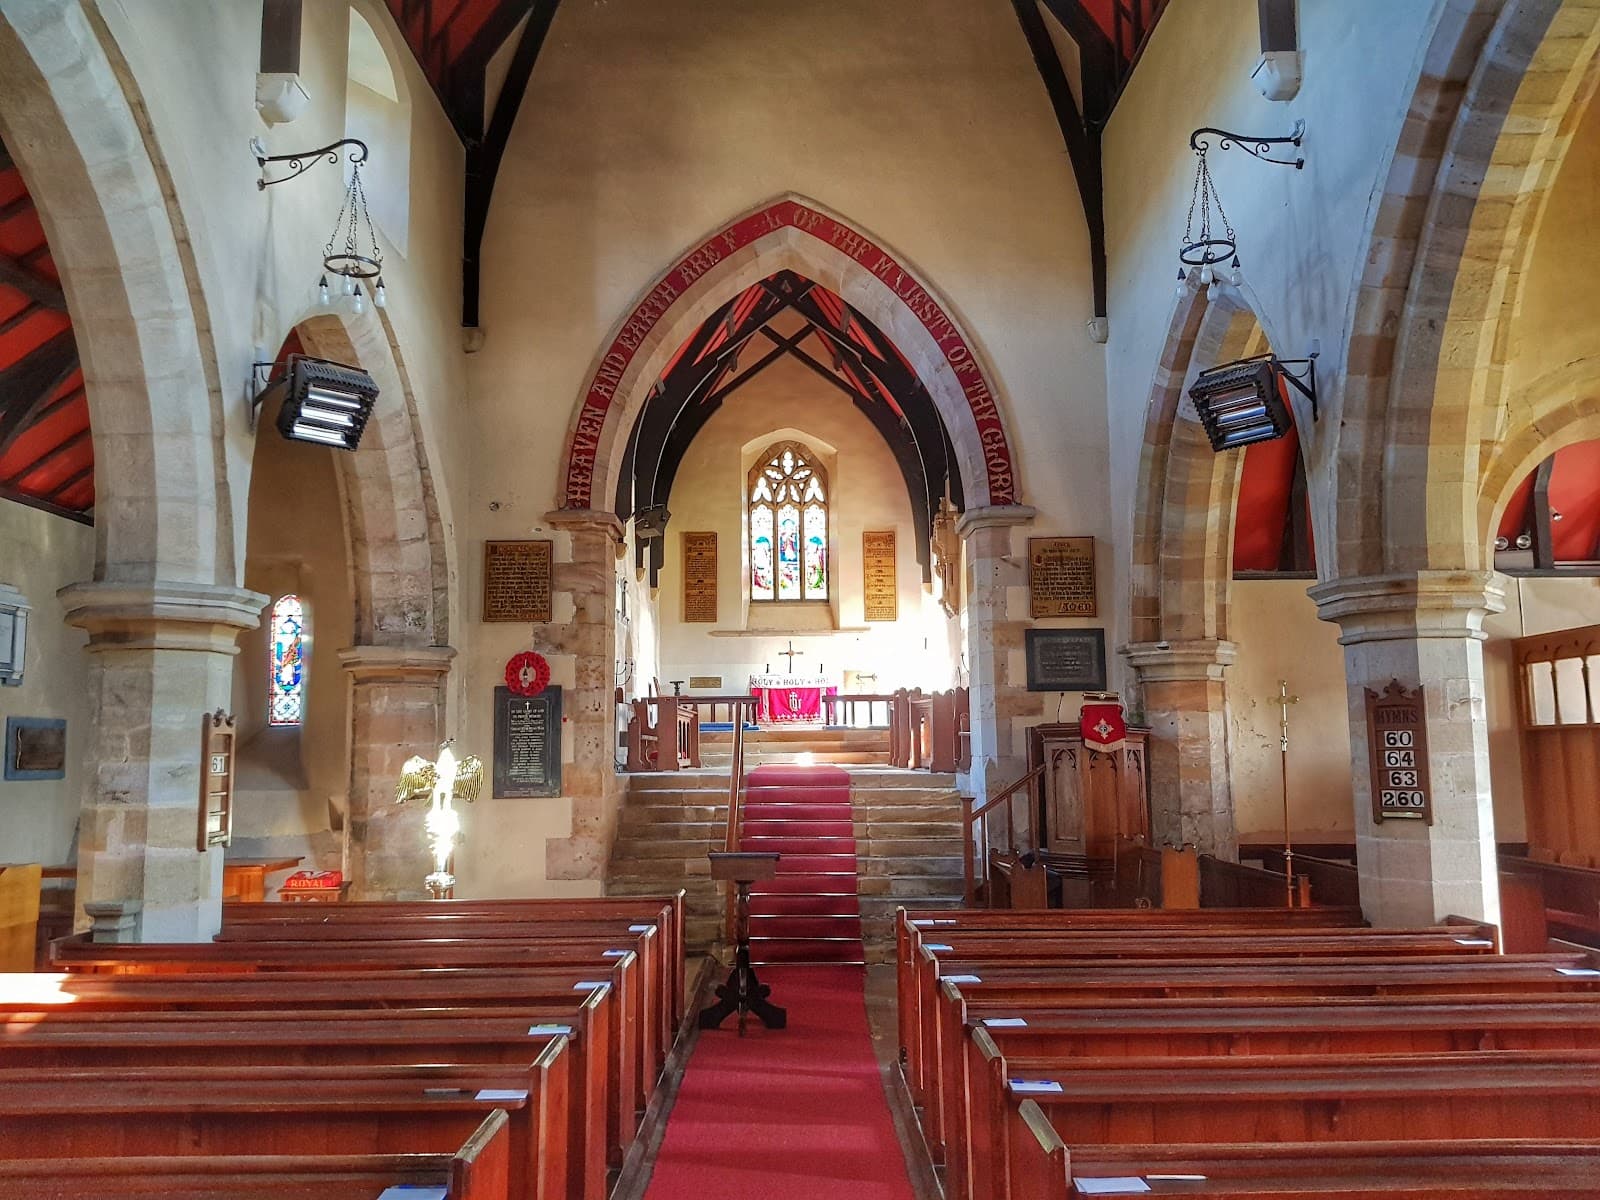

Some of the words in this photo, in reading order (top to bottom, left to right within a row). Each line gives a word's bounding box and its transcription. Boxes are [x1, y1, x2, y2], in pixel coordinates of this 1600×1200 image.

[794, 208, 824, 231] OF
[831, 224, 873, 259] THE
[678, 240, 723, 286] ARE
[618, 281, 679, 352] EARTH
[948, 344, 977, 376] OF
[592, 352, 627, 398] AND
[969, 378, 999, 420] THY
[567, 405, 605, 503] HEAVEN
[982, 427, 1014, 502] GLORY
[783, 678, 805, 686] HOLY
[1376, 709, 1418, 724] HYMNS
[1386, 731, 1412, 746] 60
[212, 757, 224, 771] 61
[1387, 751, 1413, 767] 64
[1391, 771, 1416, 786] 63
[1383, 791, 1424, 807] 260
[291, 879, 323, 888] ROYAL
